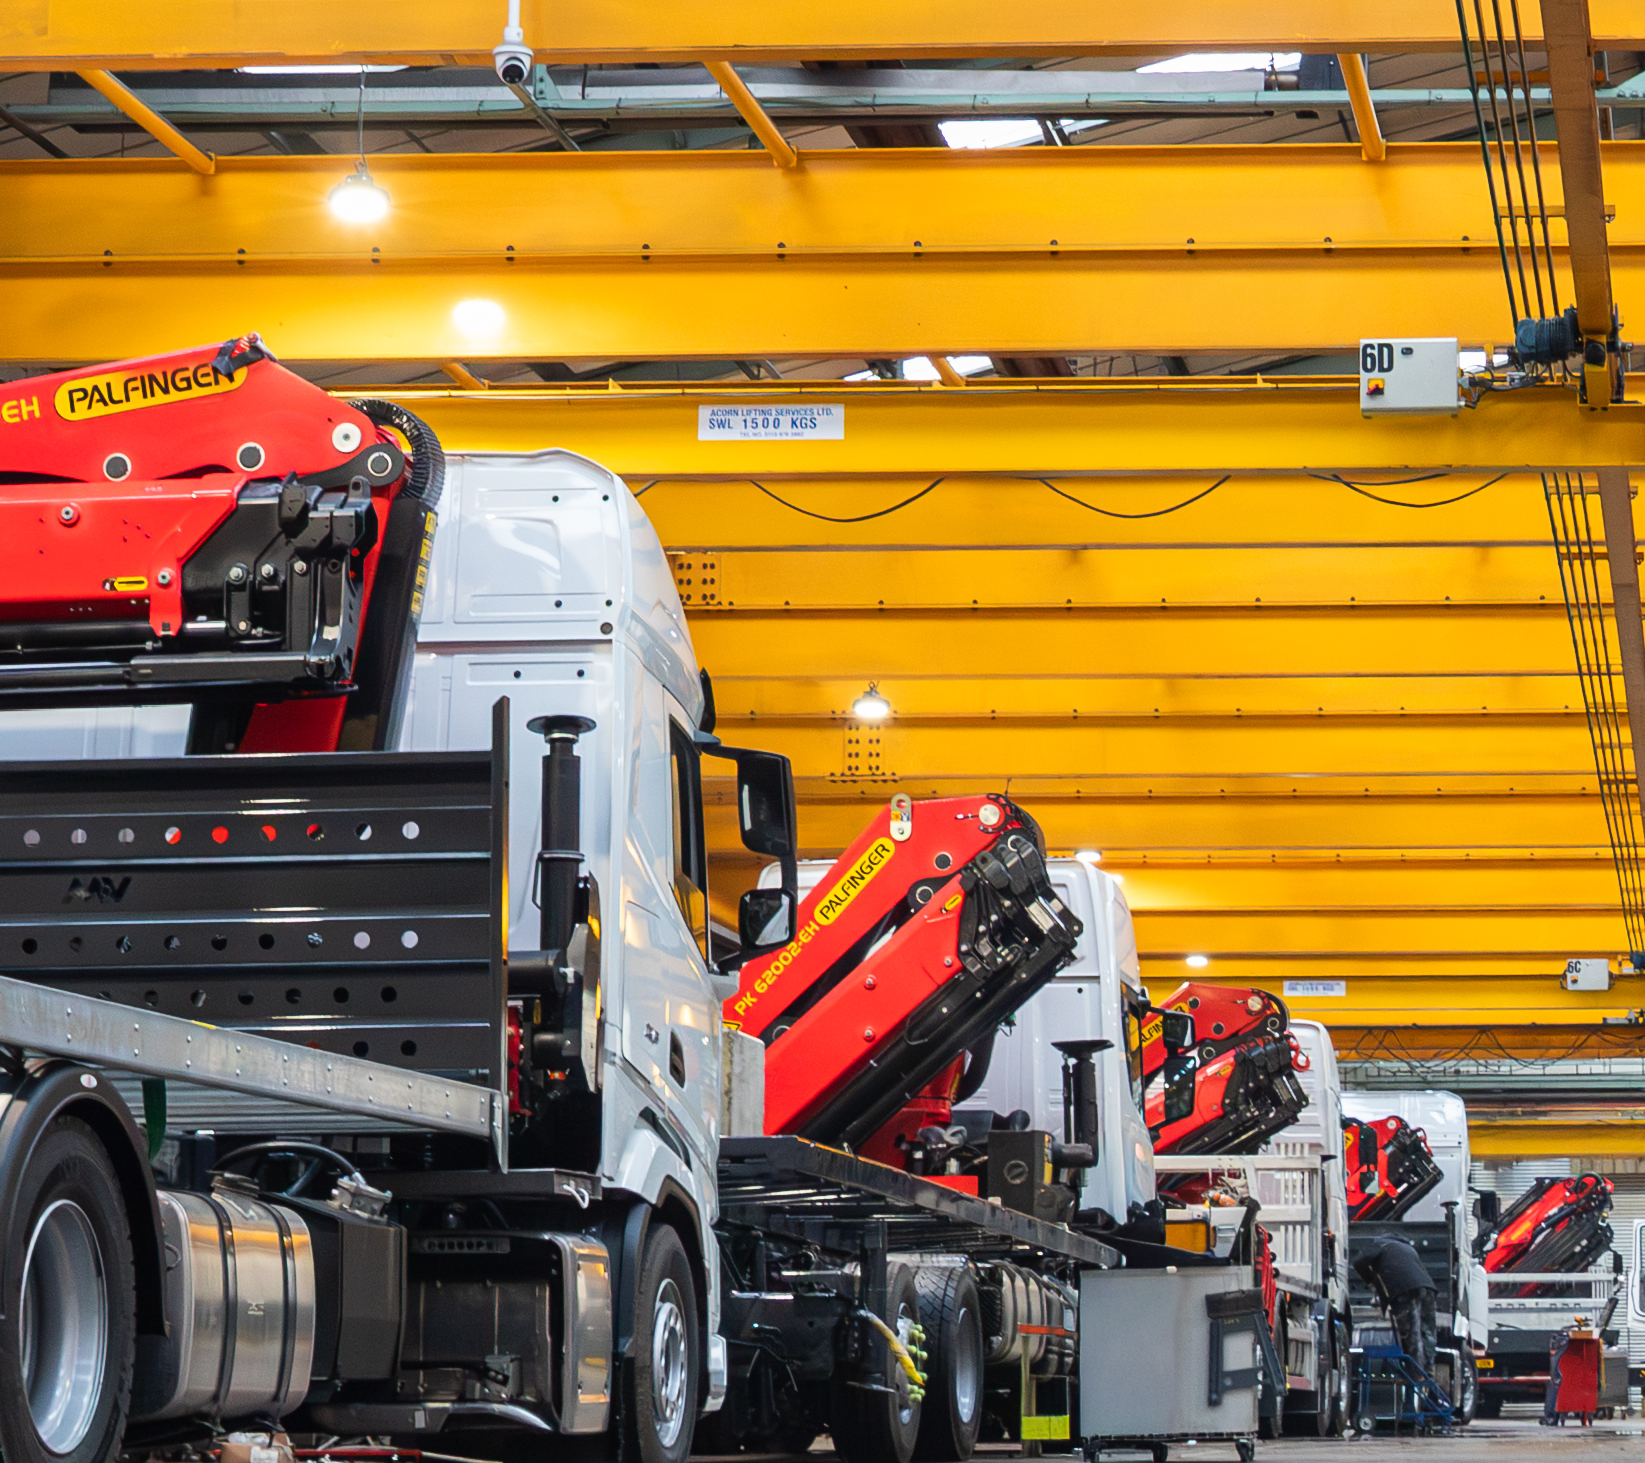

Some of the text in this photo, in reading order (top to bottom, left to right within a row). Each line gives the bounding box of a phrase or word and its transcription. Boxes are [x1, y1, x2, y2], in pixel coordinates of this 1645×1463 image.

[1361, 343, 1393, 373] 6D
[710, 409, 739, 417] ACORN
[741, 409, 773, 417] LIFTING
[775, 408, 814, 417] SERVICES
[708, 417, 818, 430] SWL 1500 KGS
[819, 843, 891, 921] PALFINGER
[1567, 960, 1582, 974] 6C
[734, 991, 757, 1016] PK
